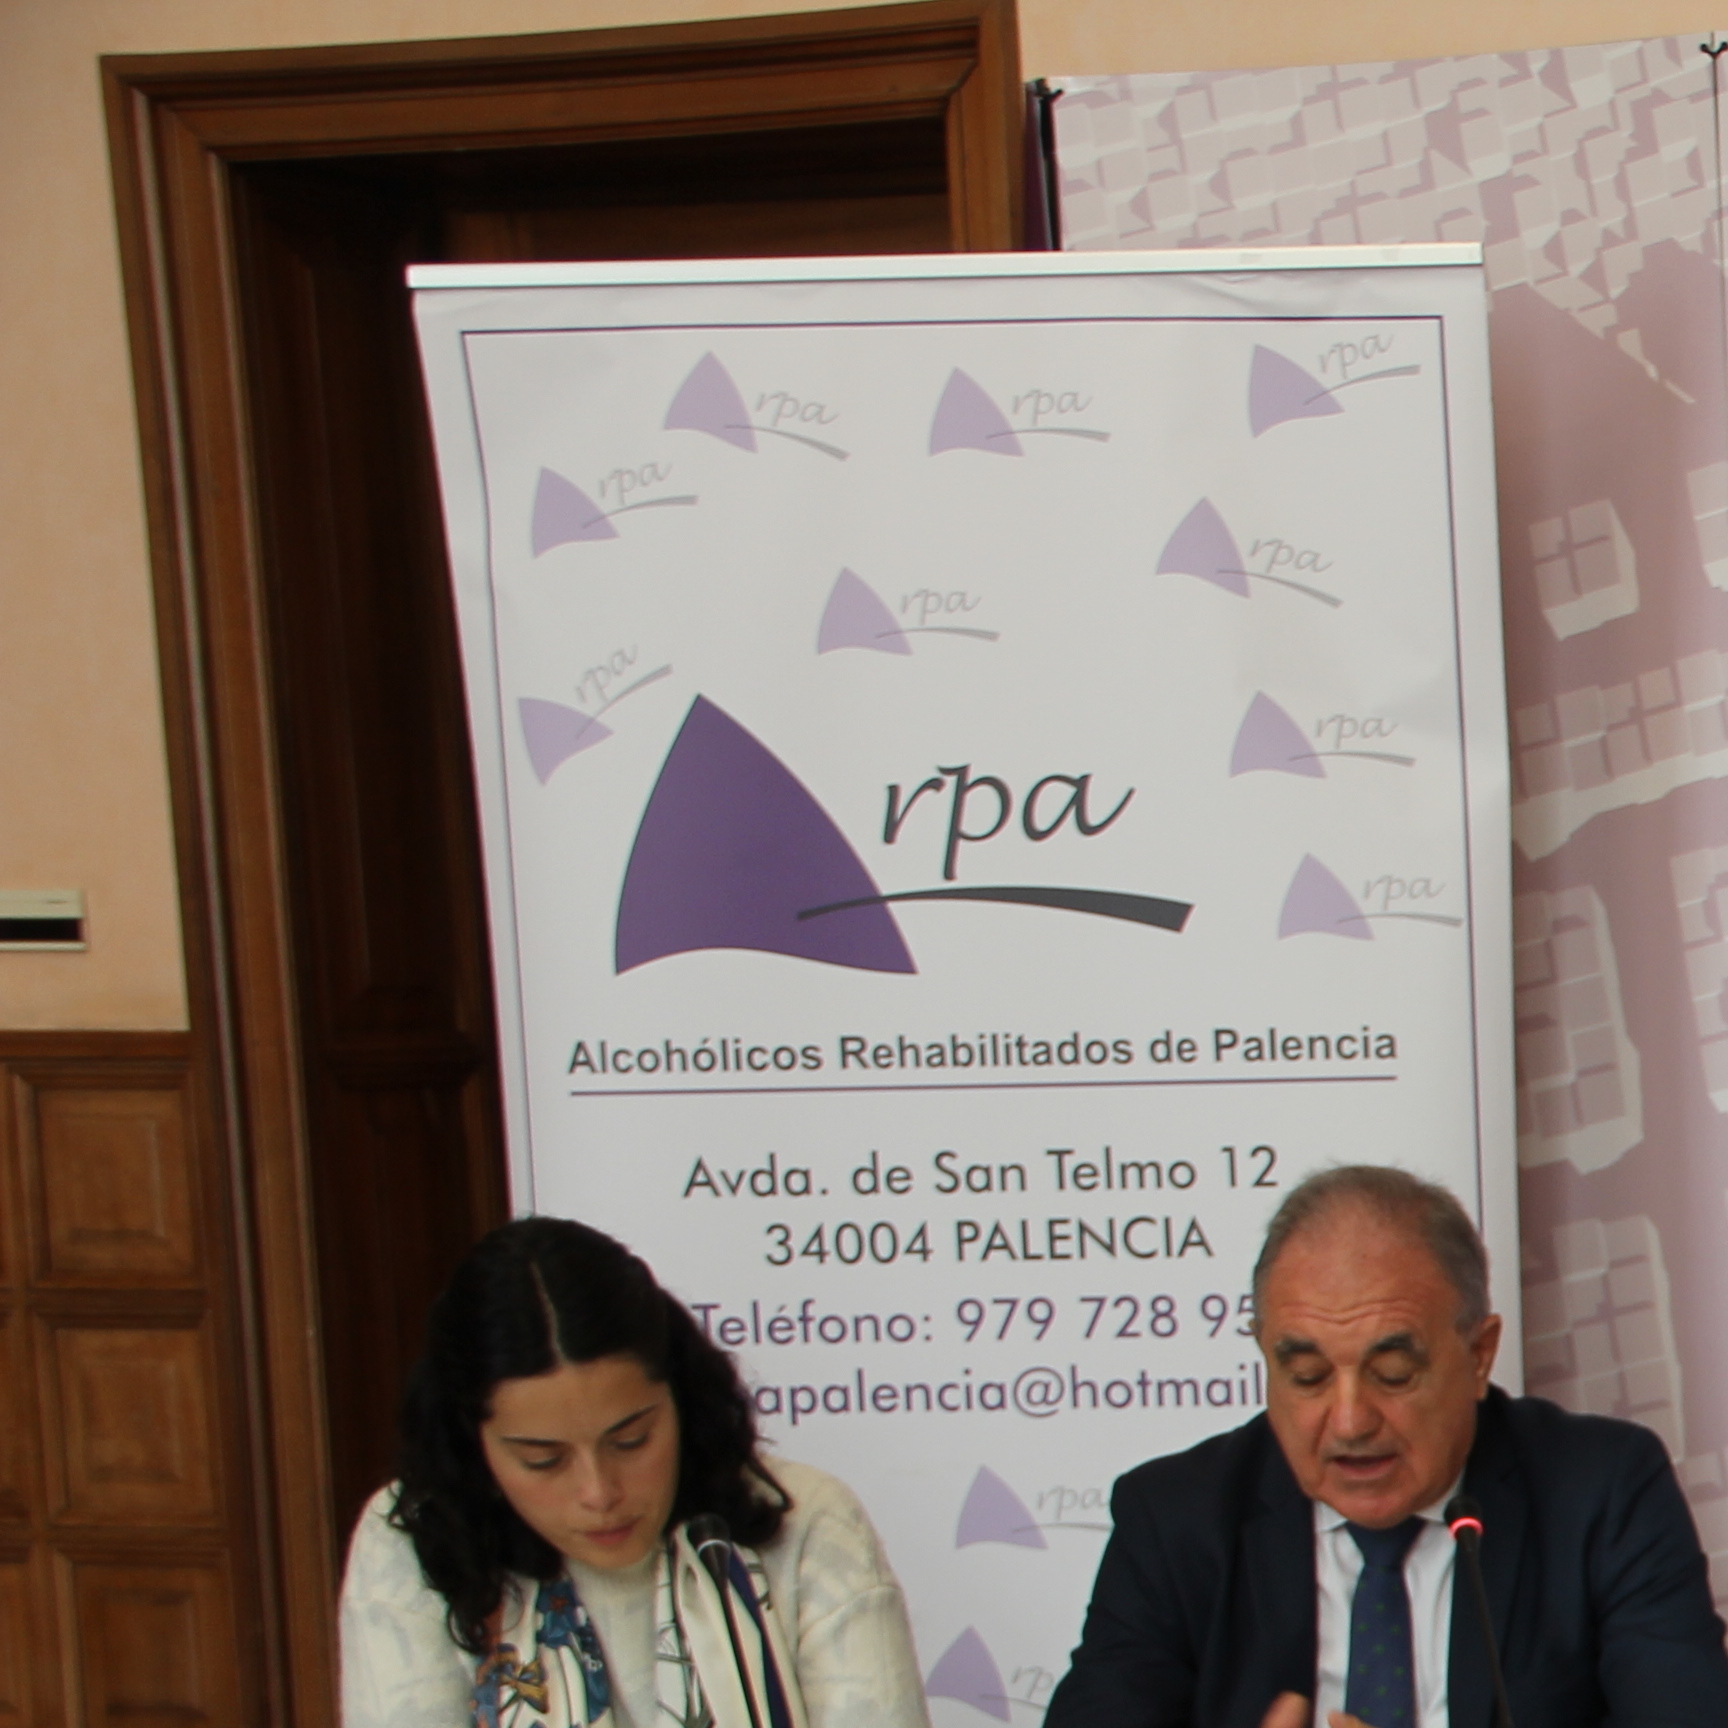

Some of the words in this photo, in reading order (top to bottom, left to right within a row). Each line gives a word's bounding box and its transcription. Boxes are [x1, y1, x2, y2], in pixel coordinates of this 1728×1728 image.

[883, 763, 1135, 880] rpa
[568, 1034, 823, 1076] Alcohólicos
[840, 1031, 1135, 1071] Rehabilitados
[1149, 1031, 1199, 1064] de
[1212, 1026, 1397, 1063] Palencia
[684, 1154, 828, 1199] Avda.
[852, 1153, 914, 1195] de
[933, 1151, 1027, 1195] San
[1047, 1147, 1197, 1190] Telmo
[1221, 1144, 1278, 1187] 12
[764, 1222, 935, 1267] 34004
[954, 1216, 1213, 1262] PALENCIA
[691, 1299, 933, 1348] Teléfono:
[955, 1299, 1056, 1343] 979
[1080, 1296, 1179, 1339] 728
[1200, 1295, 1255, 1337] 95
[754, 1363, 1268, 1424] apalencia@hotmail
